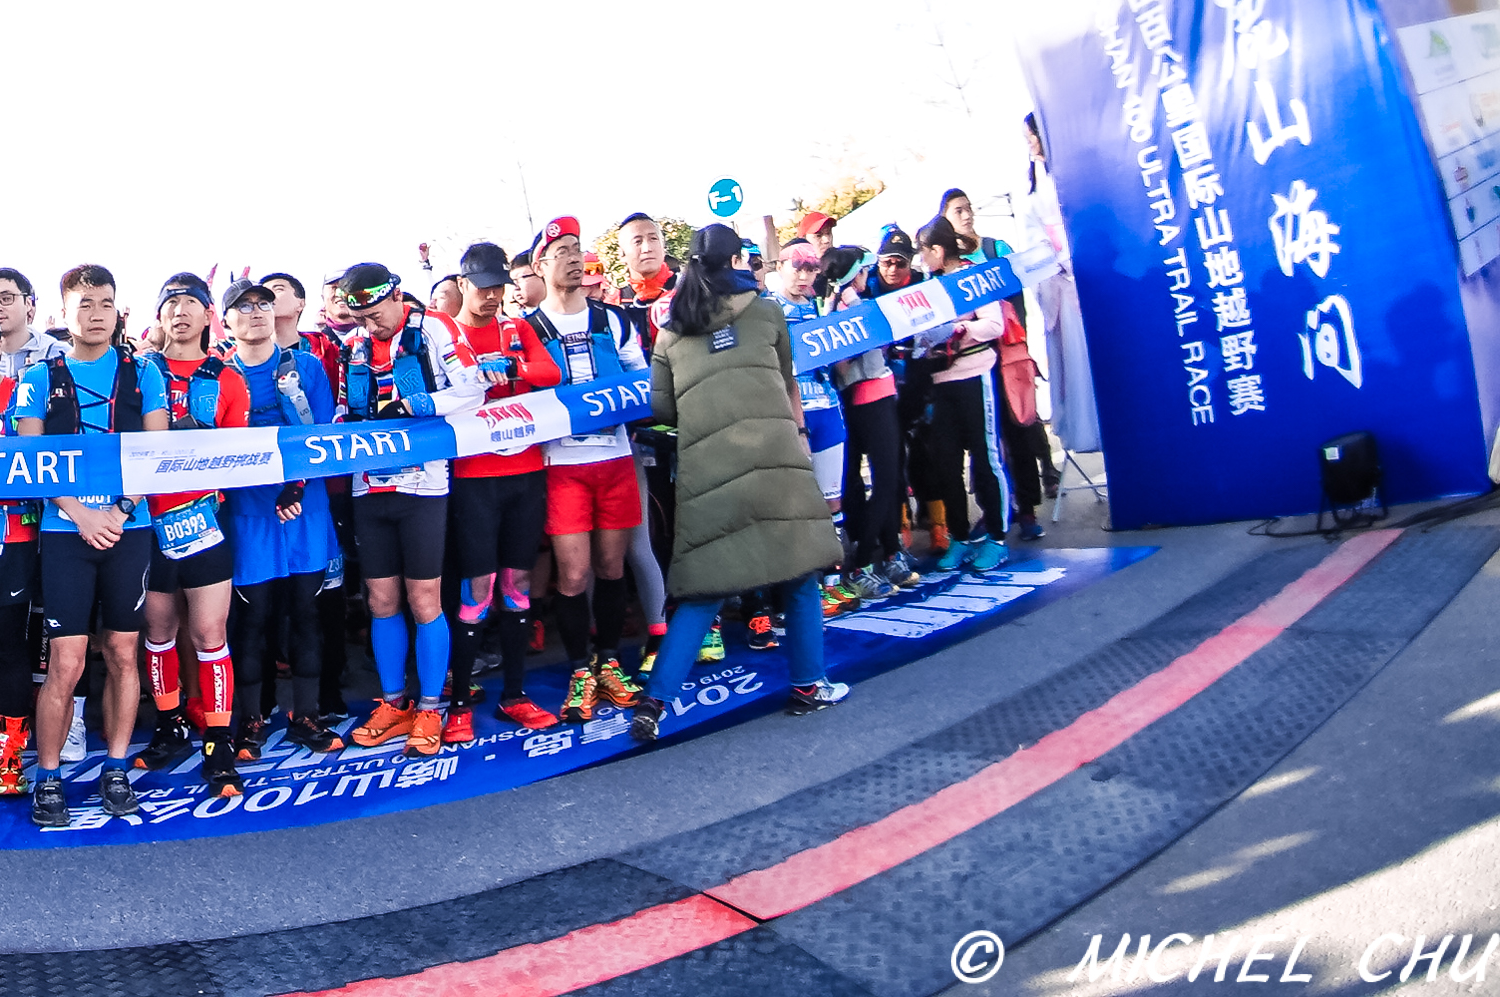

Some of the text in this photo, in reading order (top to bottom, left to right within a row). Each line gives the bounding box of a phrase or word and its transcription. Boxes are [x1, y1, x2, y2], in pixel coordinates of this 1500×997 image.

[957, 266, 1007, 302] START
[1135, 147, 1183, 248] ULTRA
[1162, 251, 1198, 339] TRAIL
[1180, 341, 1217, 427] RACE
[801, 315, 870, 358] START
[582, 379, 651, 417] STAR
[155, 451, 274, 474] 国际山地越野挑战赛
[305, 429, 412, 465] START
[164, 512, 207, 542] B0393
[698, 664, 745, 687] 2019
